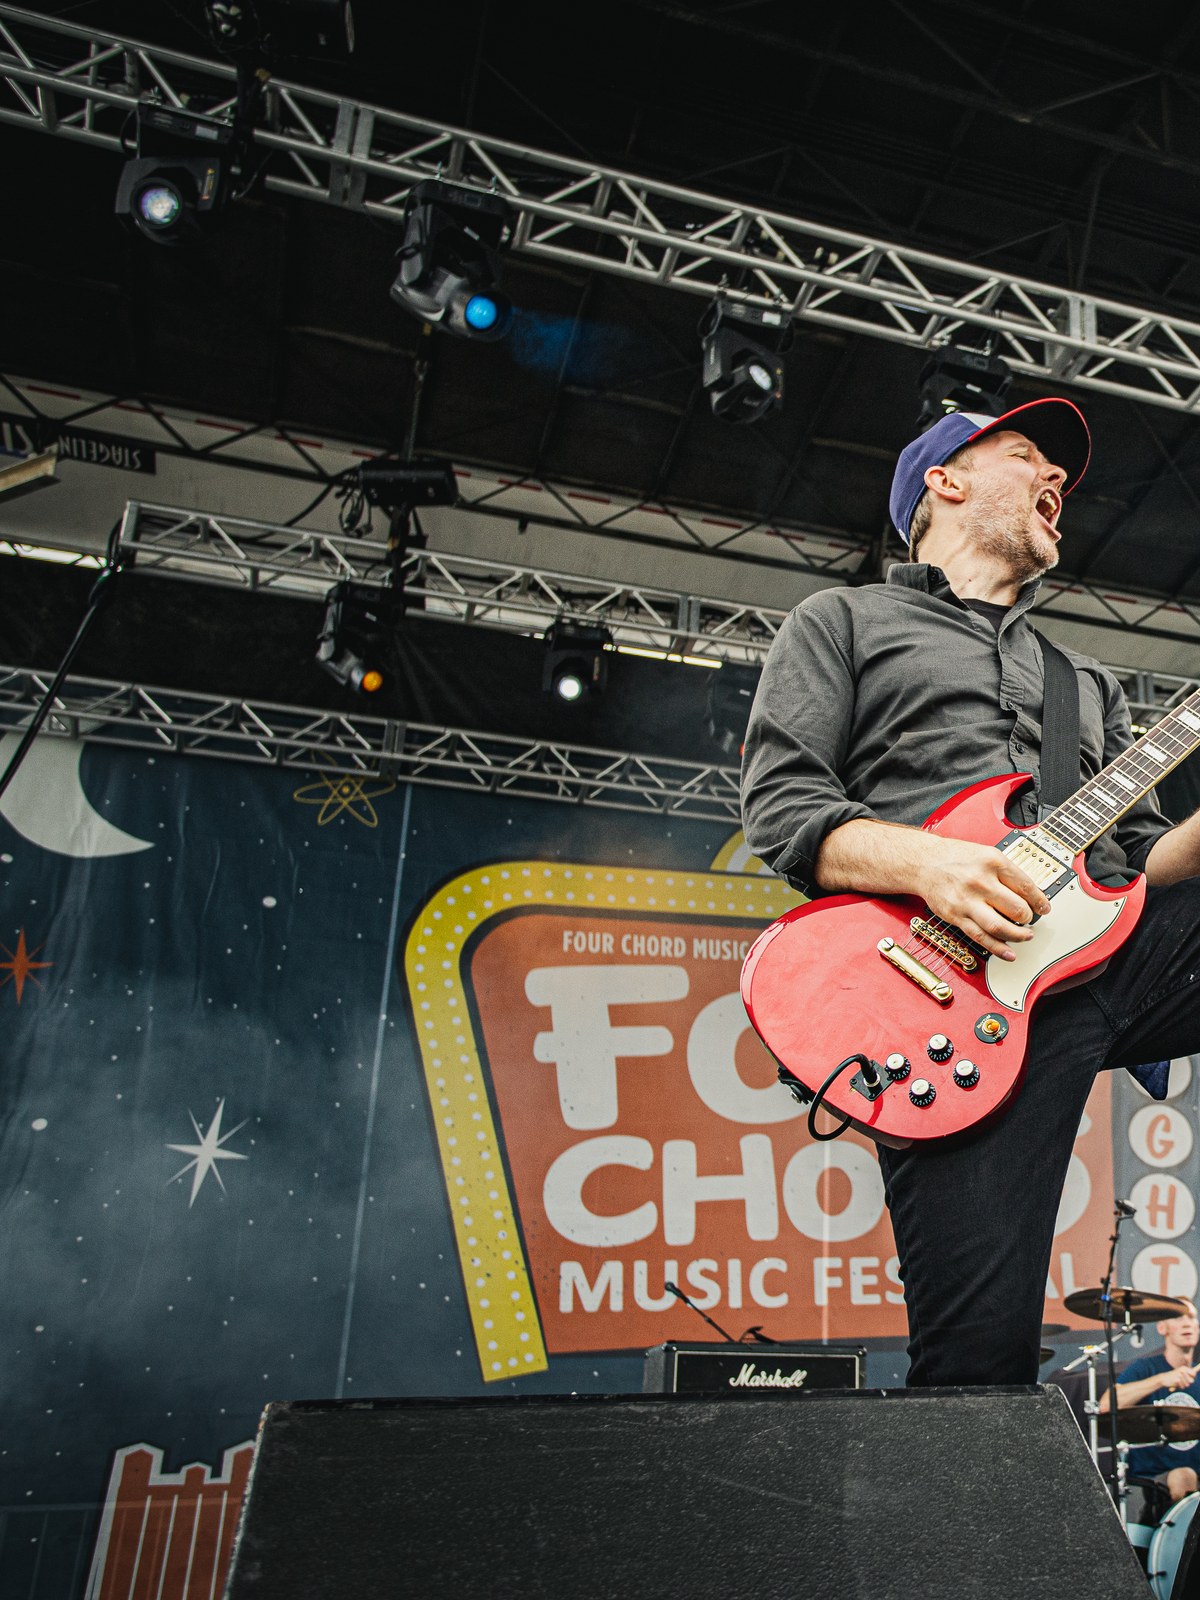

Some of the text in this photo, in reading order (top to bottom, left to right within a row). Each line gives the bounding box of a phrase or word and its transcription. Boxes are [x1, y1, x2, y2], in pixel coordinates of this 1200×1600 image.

[58, 434, 141, 469] STAGELIN
[562, 930, 749, 960] FOUR CHORD MUSIC
[543, 1133, 1091, 1247] CHO
[558, 1257, 789, 1313] MUSIC
[728, 1363, 807, 1388] Marshall
